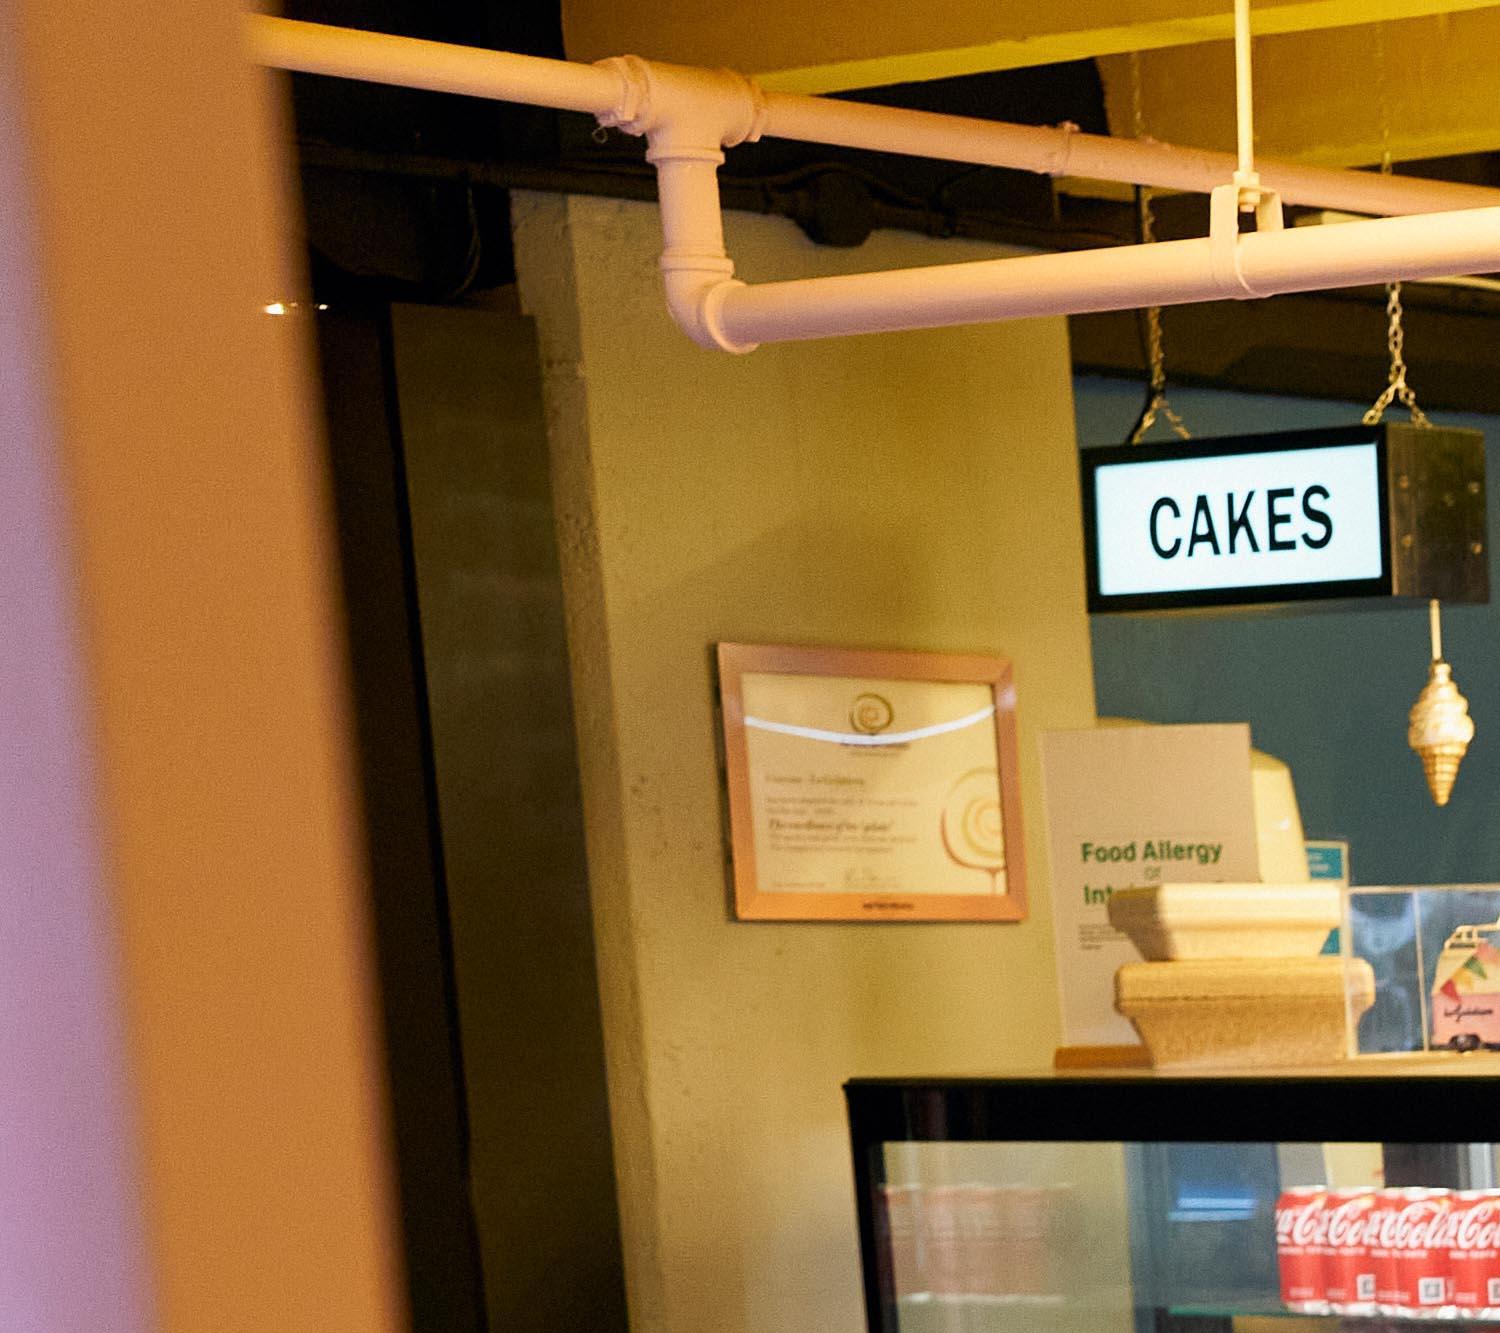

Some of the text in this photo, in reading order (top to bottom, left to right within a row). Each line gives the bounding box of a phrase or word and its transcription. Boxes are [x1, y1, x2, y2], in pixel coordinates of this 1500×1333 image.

[1148, 485, 1334, 560] CAKES
[1080, 840, 1223, 864] Food Allergy
